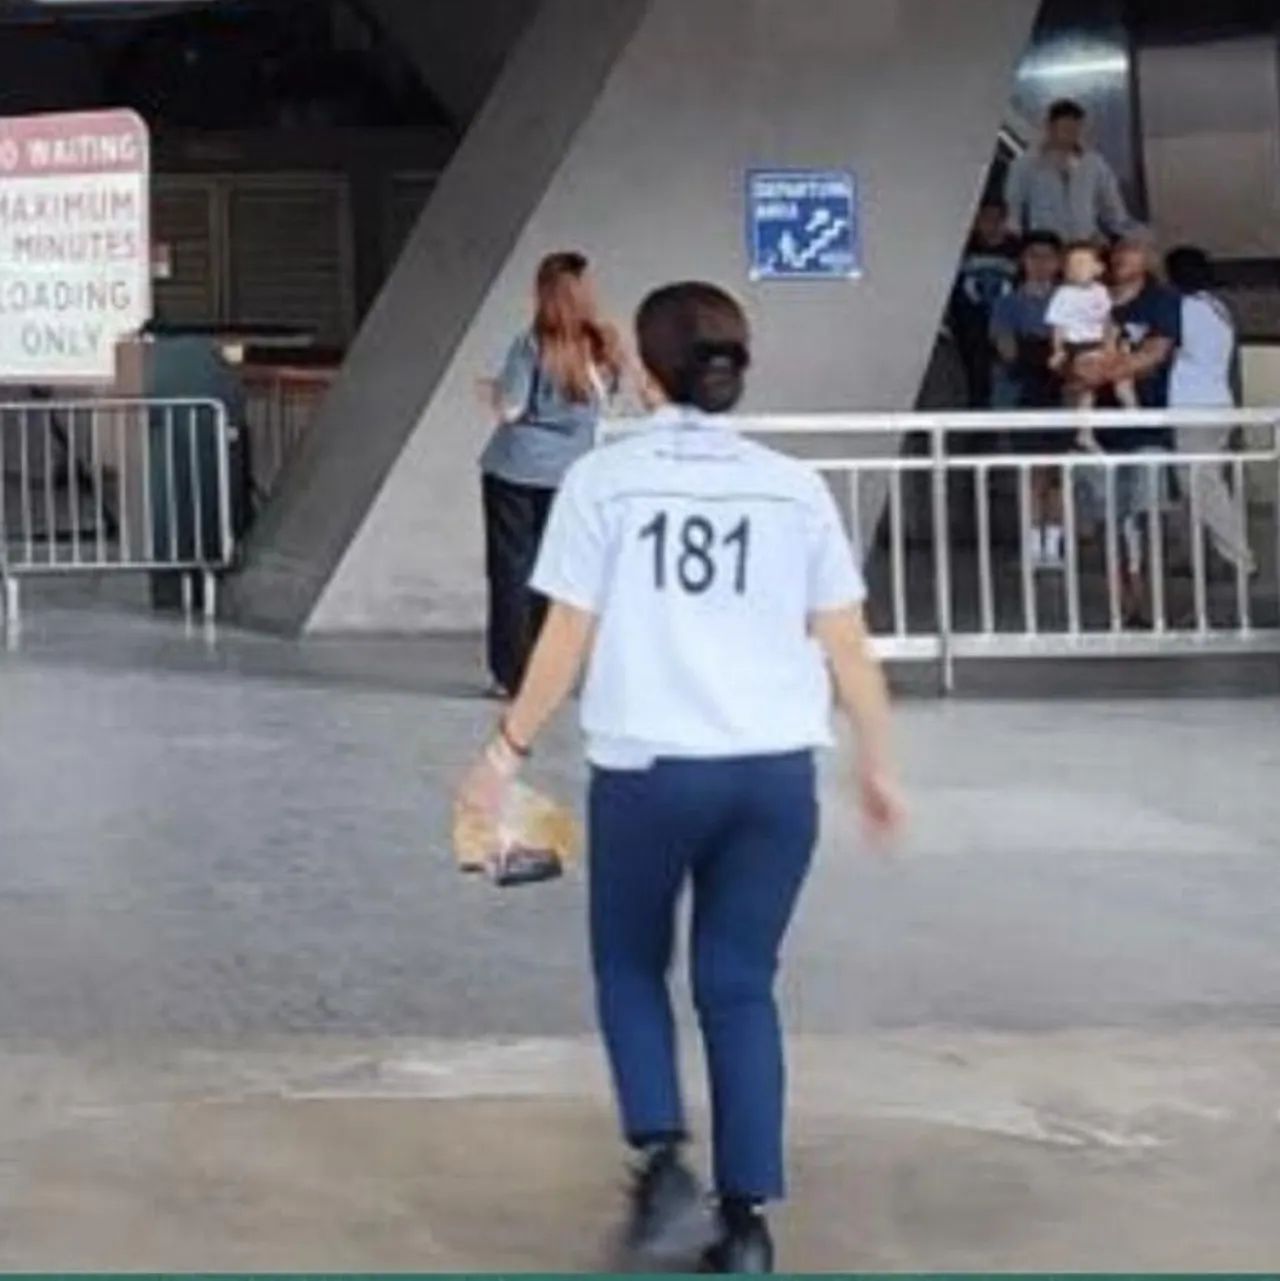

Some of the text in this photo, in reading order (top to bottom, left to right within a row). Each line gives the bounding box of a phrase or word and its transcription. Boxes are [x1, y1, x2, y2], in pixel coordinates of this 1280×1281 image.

[24, 133, 136, 167] WAITING
[13, 231, 138, 262] MINUTES
[21, 323, 103, 357] ONLY
[639, 510, 751, 595] 181
